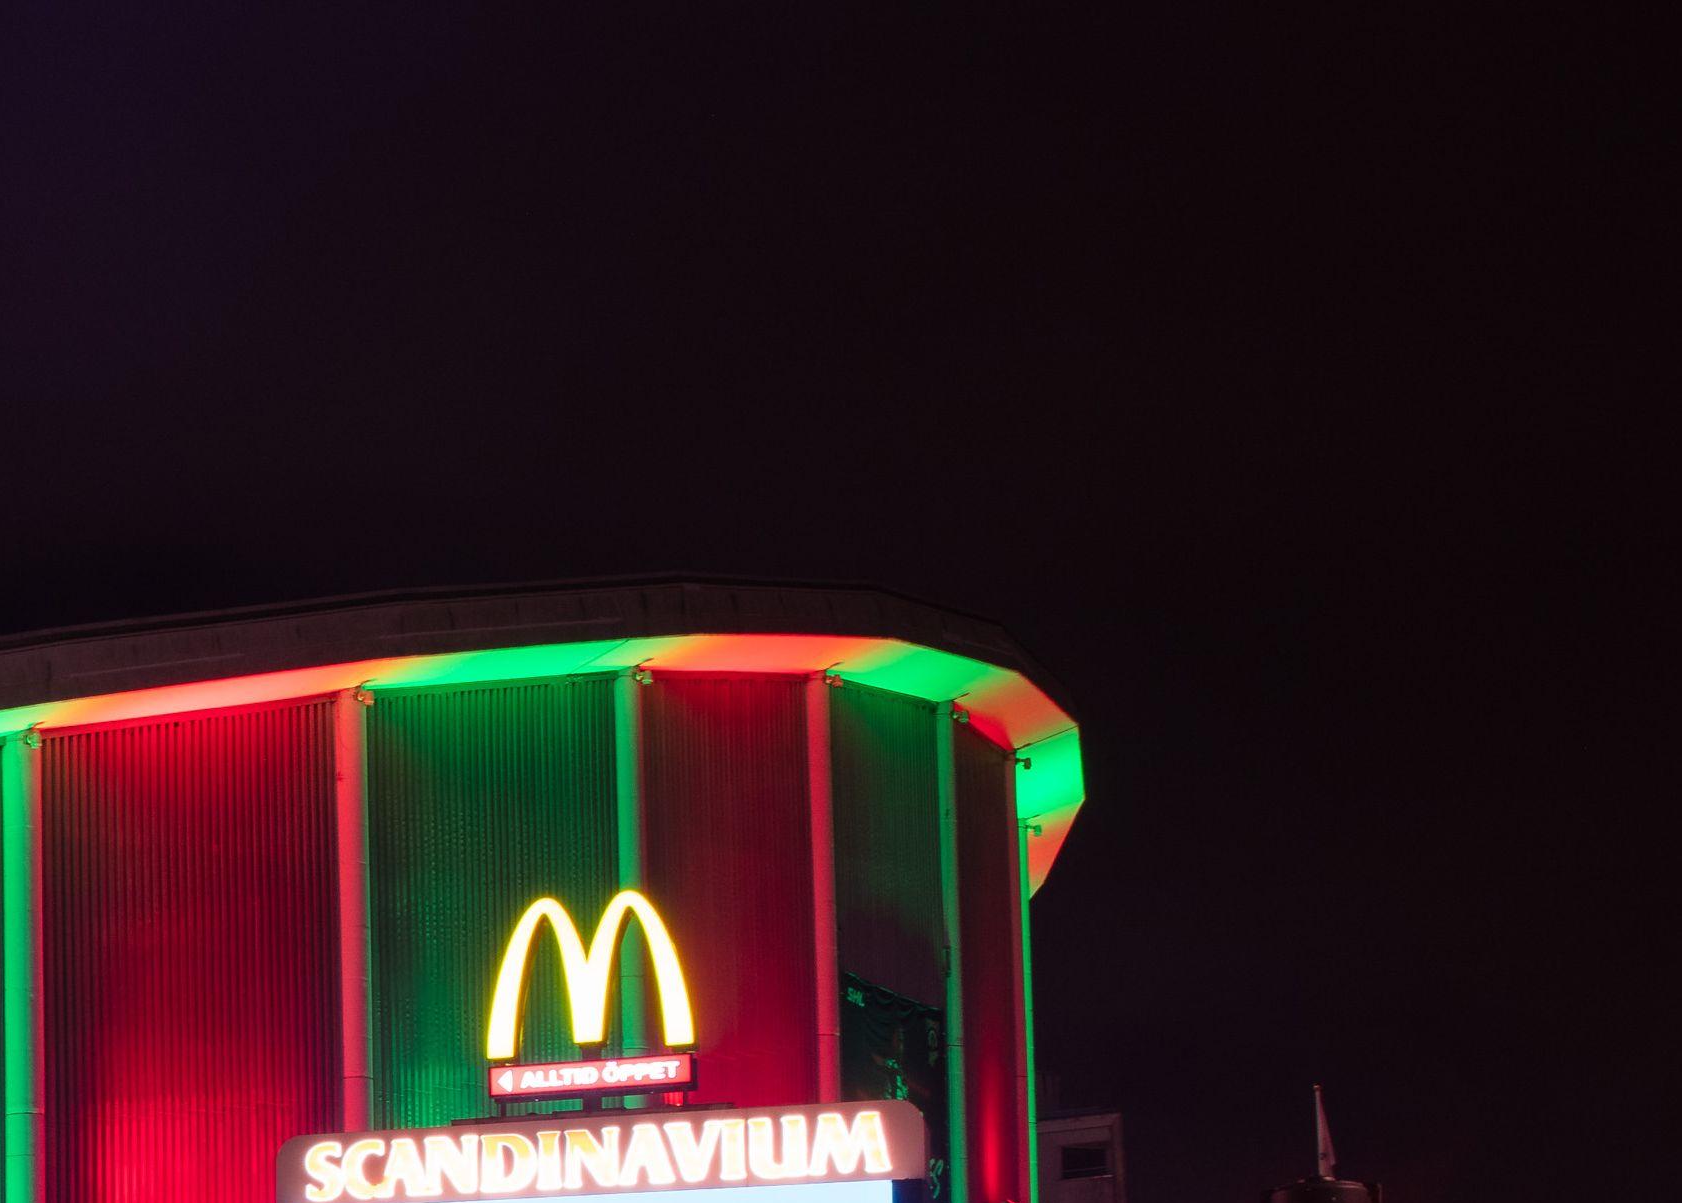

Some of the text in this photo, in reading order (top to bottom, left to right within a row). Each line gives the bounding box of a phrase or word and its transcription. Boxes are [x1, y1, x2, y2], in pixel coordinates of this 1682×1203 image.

[520, 1060, 680, 1089] ALLTID ÖPPET
[304, 1111, 893, 1202] SCANDINAVIUM
